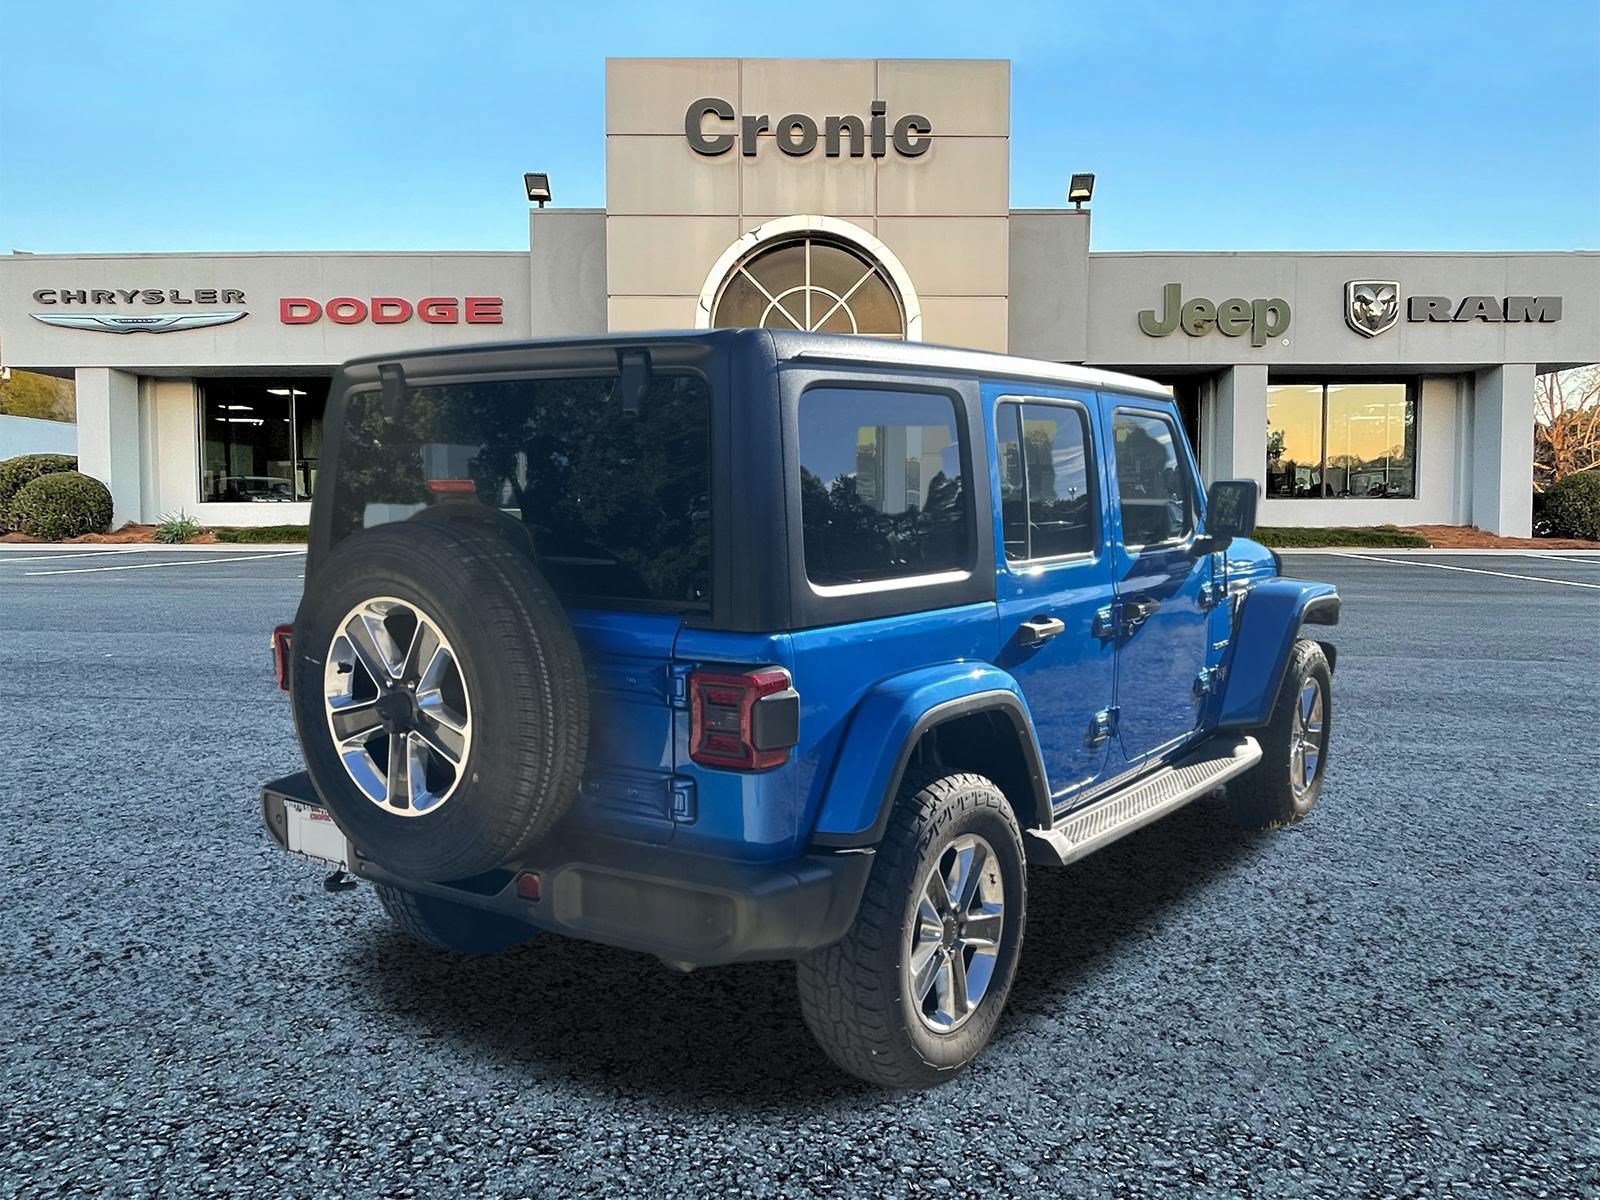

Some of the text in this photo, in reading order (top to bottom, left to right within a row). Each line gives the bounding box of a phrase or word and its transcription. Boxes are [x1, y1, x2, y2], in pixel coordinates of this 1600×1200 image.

[685, 97, 932, 158] Cronic
[32, 289, 246, 304] CHRYSLER
[1407, 296, 1563, 322] RAM
[280, 297, 503, 325] DODGE
[1138, 283, 1291, 347] Jeep
